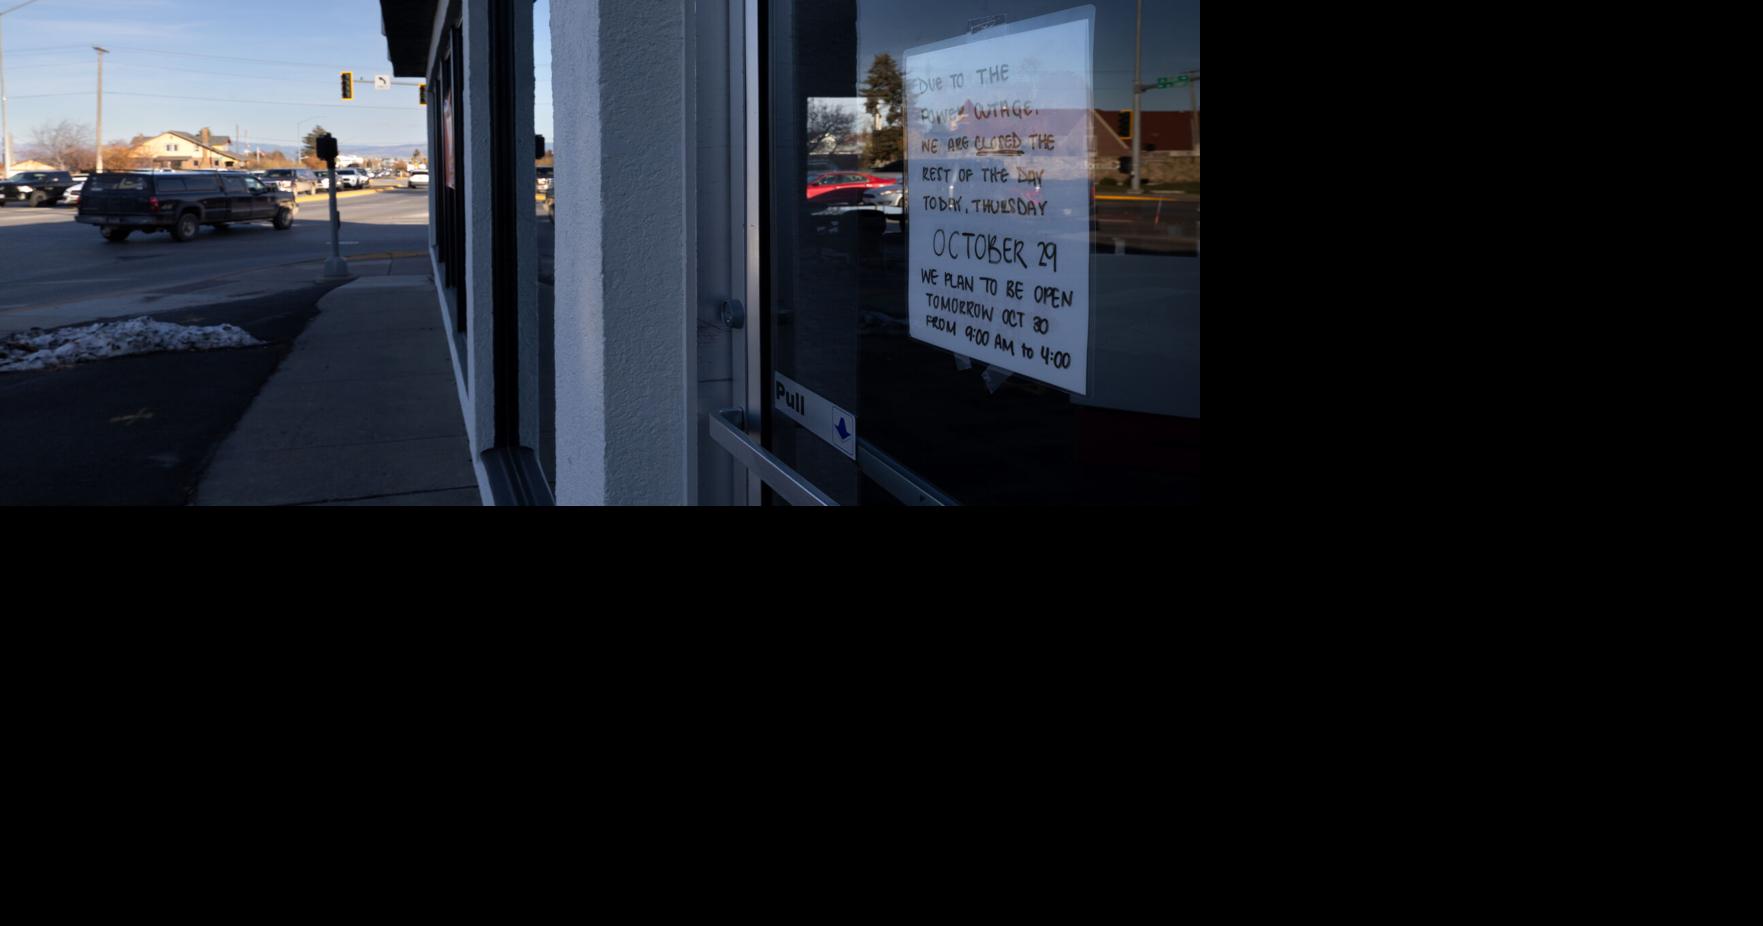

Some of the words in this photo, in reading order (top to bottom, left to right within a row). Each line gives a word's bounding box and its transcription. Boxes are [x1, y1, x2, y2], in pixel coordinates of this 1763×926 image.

[950, 73, 964, 89] TO
[976, 64, 1009, 85] THE
[921, 138, 938, 153] WE
[948, 136, 969, 151] ARE
[974, 131, 1022, 150] CLOSED
[1029, 133, 1055, 151] THE
[922, 167, 951, 182] REST
[958, 168, 974, 182] OF
[982, 167, 1009, 183] THE
[1016, 166, 1044, 187] DAY
[923, 195, 969, 215] TODAY,
[933, 228, 1028, 269] OCTOBER
[1036, 241, 1057, 273] 29
[921, 268, 939, 285] WE
[944, 271, 974, 293] PLAN
[979, 276, 998, 297] TO
[1006, 279, 1025, 301] BE
[1033, 284, 1074, 309] OPEN
[926, 292, 994, 323] TOMORROW
[1002, 308, 1025, 329] OCT
[1032, 315, 1049, 336] 30
[925, 314, 957, 337] FROM
[965, 325, 990, 347] 9:00
[994, 333, 1015, 357] AM
[1021, 343, 1034, 360] to
[1040, 345, 1071, 370] 4:00
[775, 379, 805, 417] Pull
